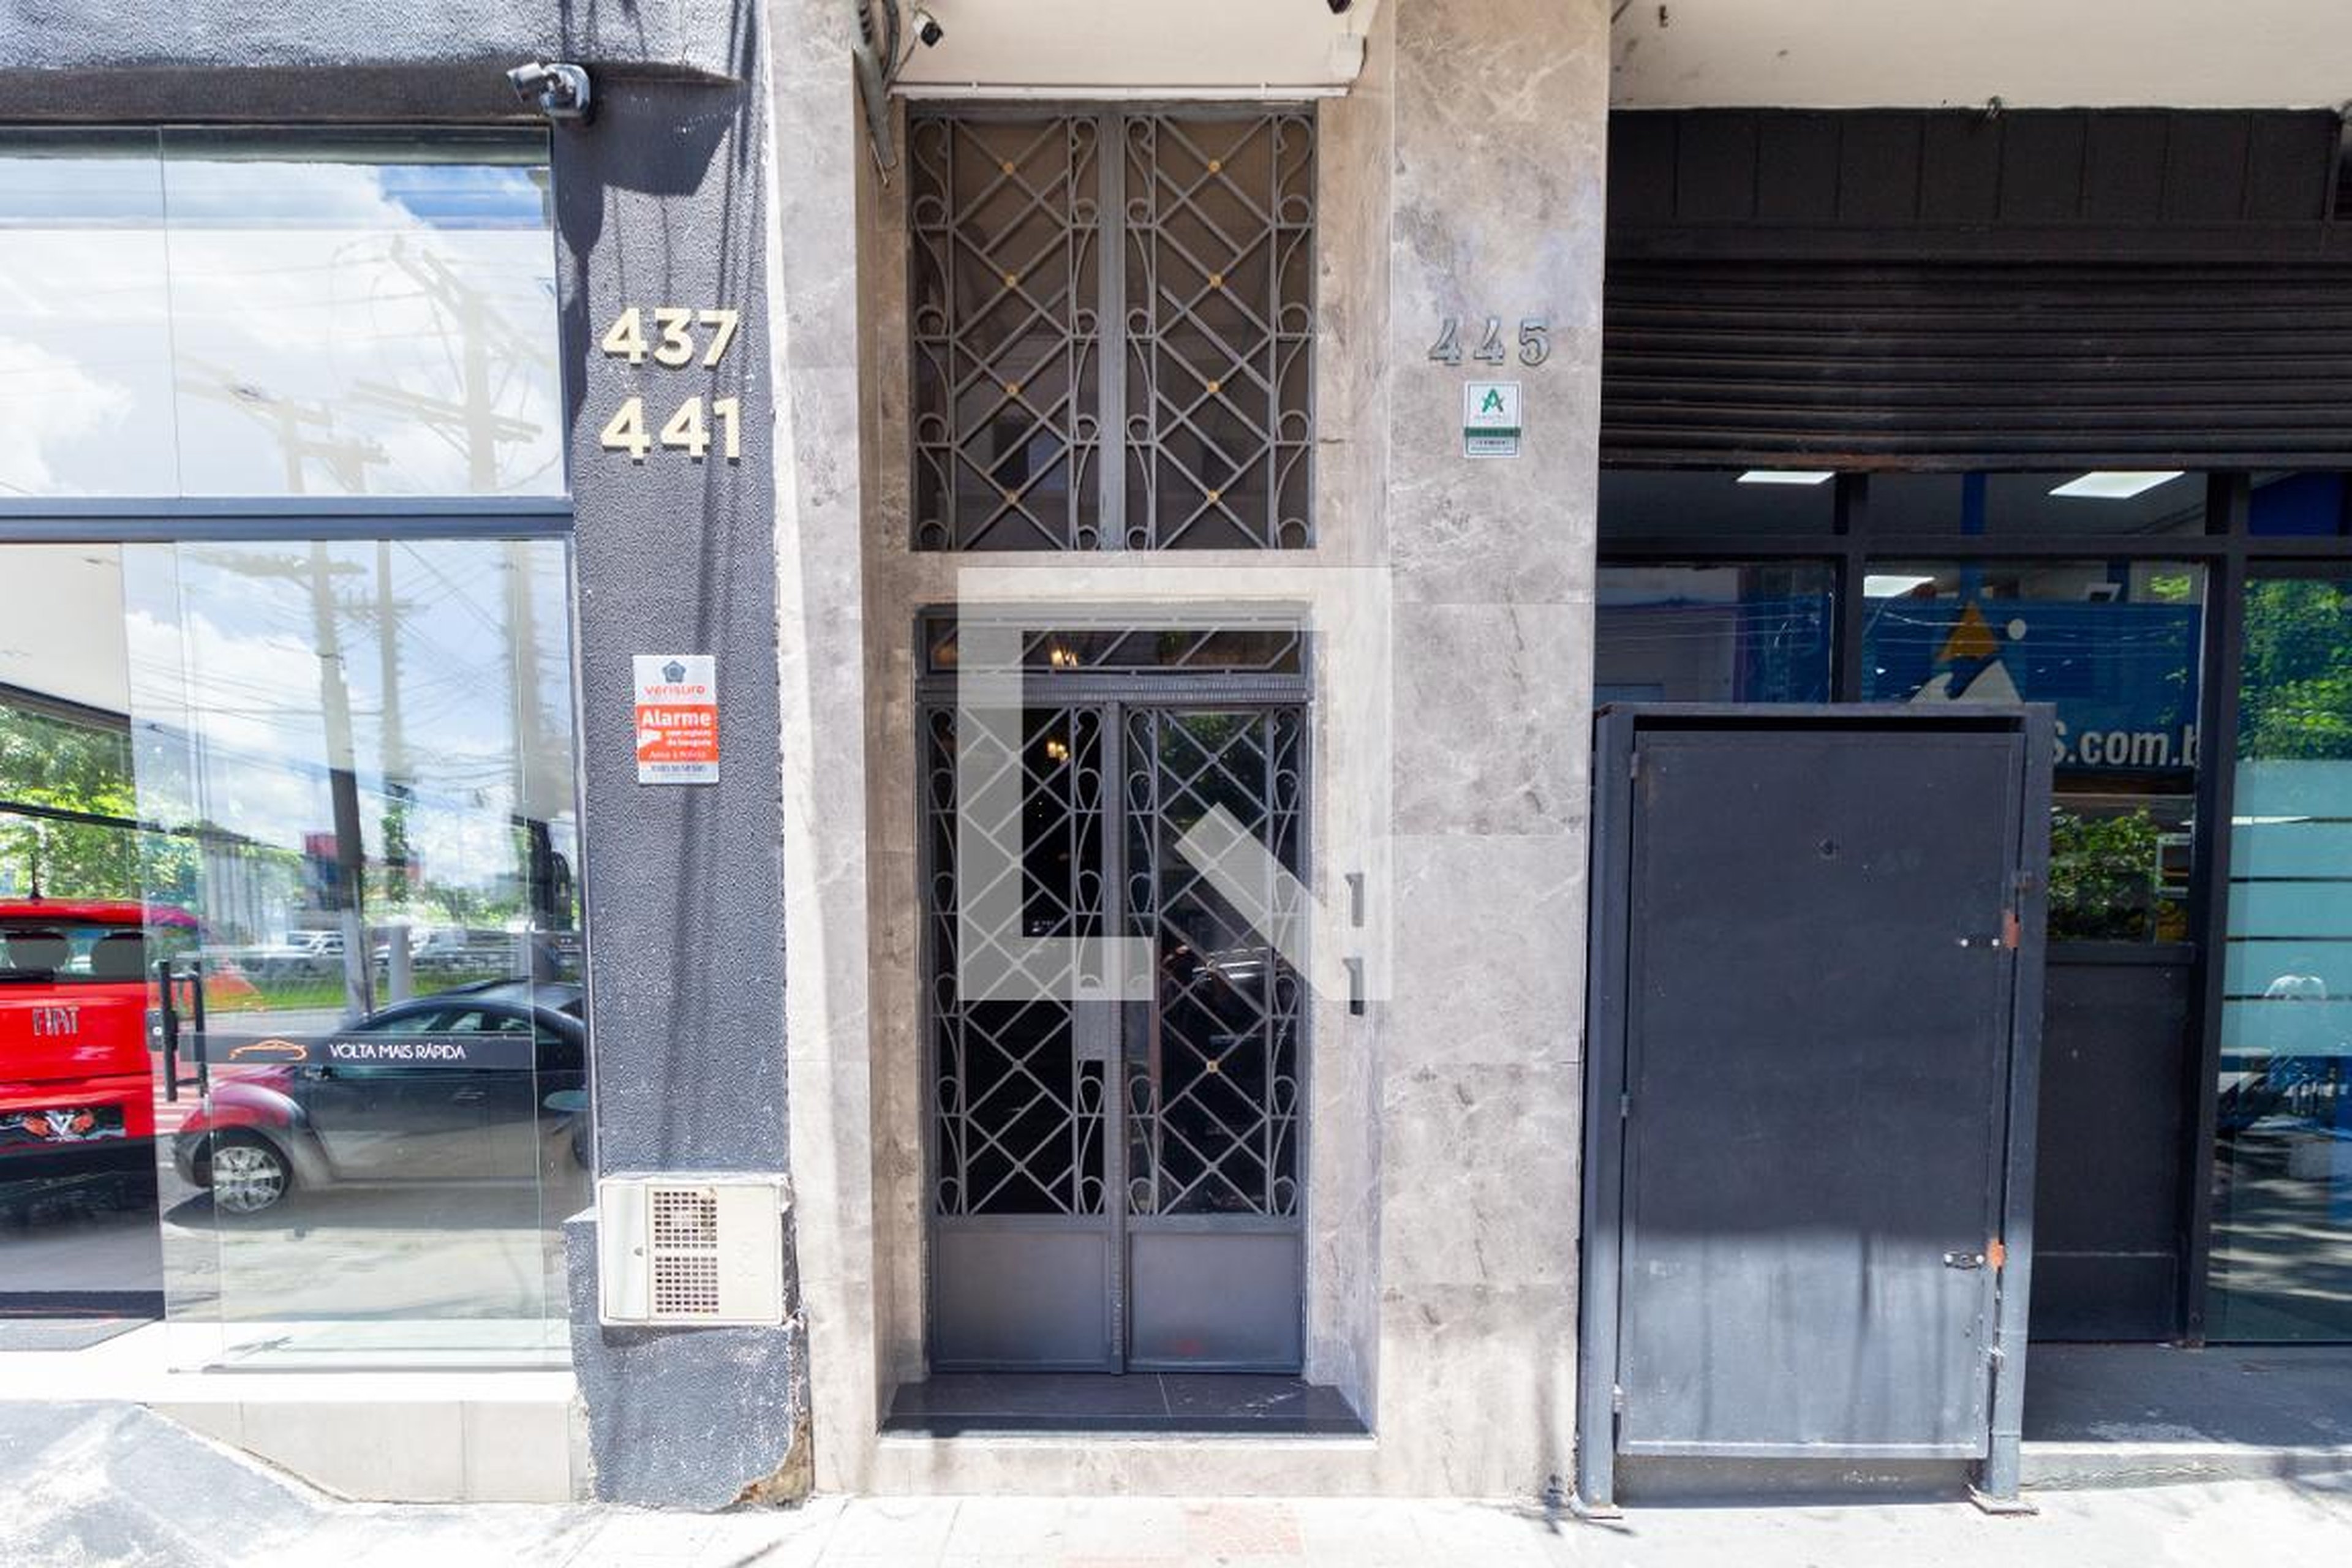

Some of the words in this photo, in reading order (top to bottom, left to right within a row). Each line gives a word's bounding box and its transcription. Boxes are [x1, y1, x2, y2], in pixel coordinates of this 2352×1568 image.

[602, 307, 738, 367] 437
[1428, 318, 1550, 366] 445
[600, 396, 741, 459] 441
[642, 709, 711, 727] Alarme
[33, 1007, 80, 1036] FIAT
[329, 1043, 376, 1058] VOLTA
[378, 1044, 413, 1058] MAIS
[415, 1042, 466, 1059] RÁPIDA
